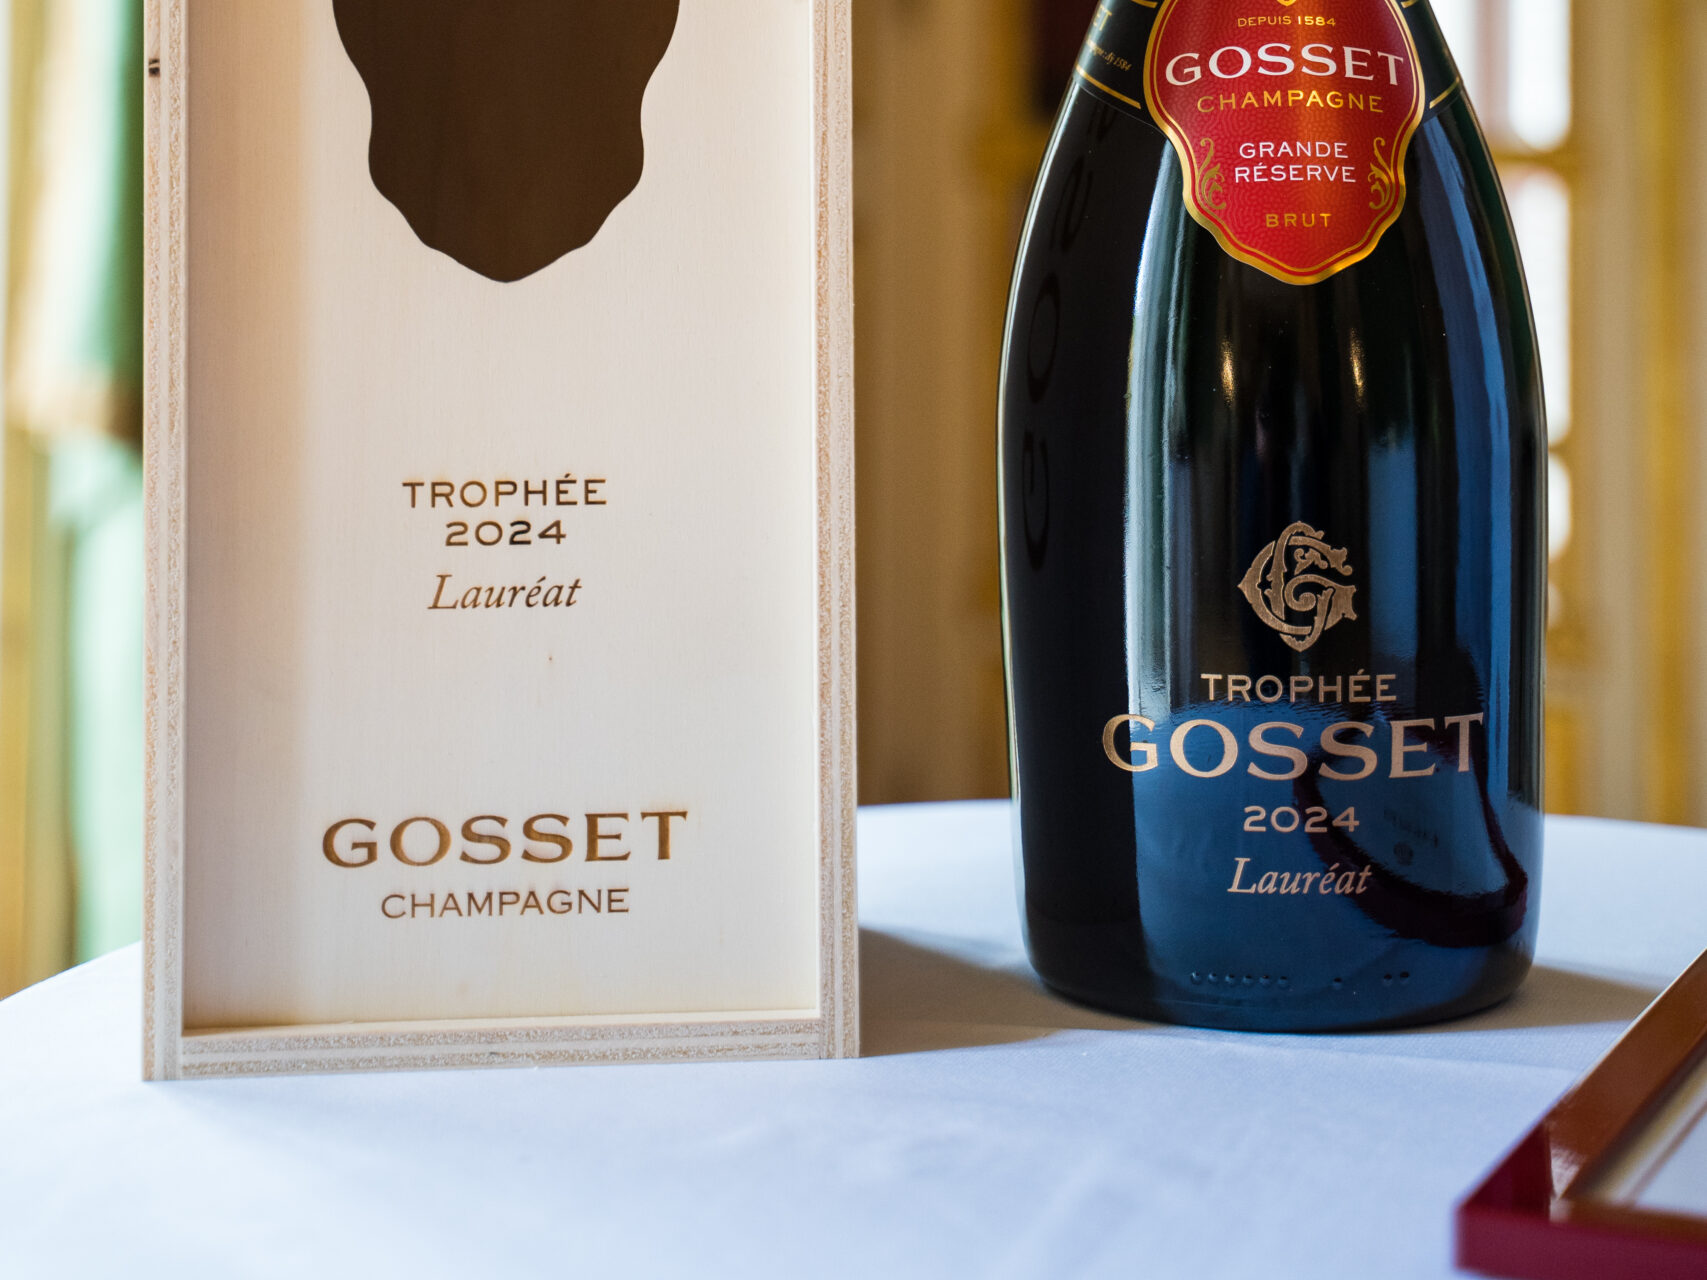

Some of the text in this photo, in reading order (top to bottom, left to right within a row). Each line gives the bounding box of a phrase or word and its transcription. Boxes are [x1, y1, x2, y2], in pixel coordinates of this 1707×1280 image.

[1237, 15, 1336, 28] DEPUIS 1584
[1165, 42, 1404, 86] GOSSET
[1197, 90, 1384, 113] CHAMPAGNE
[1239, 141, 1348, 159] GRANDE
[1234, 162, 1356, 183] RÉSERVE
[1265, 213, 1332, 228] BRUT
[402, 473, 607, 509] TROPHÉE
[445, 519, 567, 547] 2024
[427, 574, 582, 610] Lauréat
[1200, 670, 1397, 703] TROPHÉE
[1102, 712, 1484, 781] GOSSET
[1243, 806, 1360, 834] 2024
[322, 810, 688, 869] GOSSET
[1227, 856, 1373, 895] Lauréat
[381, 888, 630, 920] CHAMPAGNE
